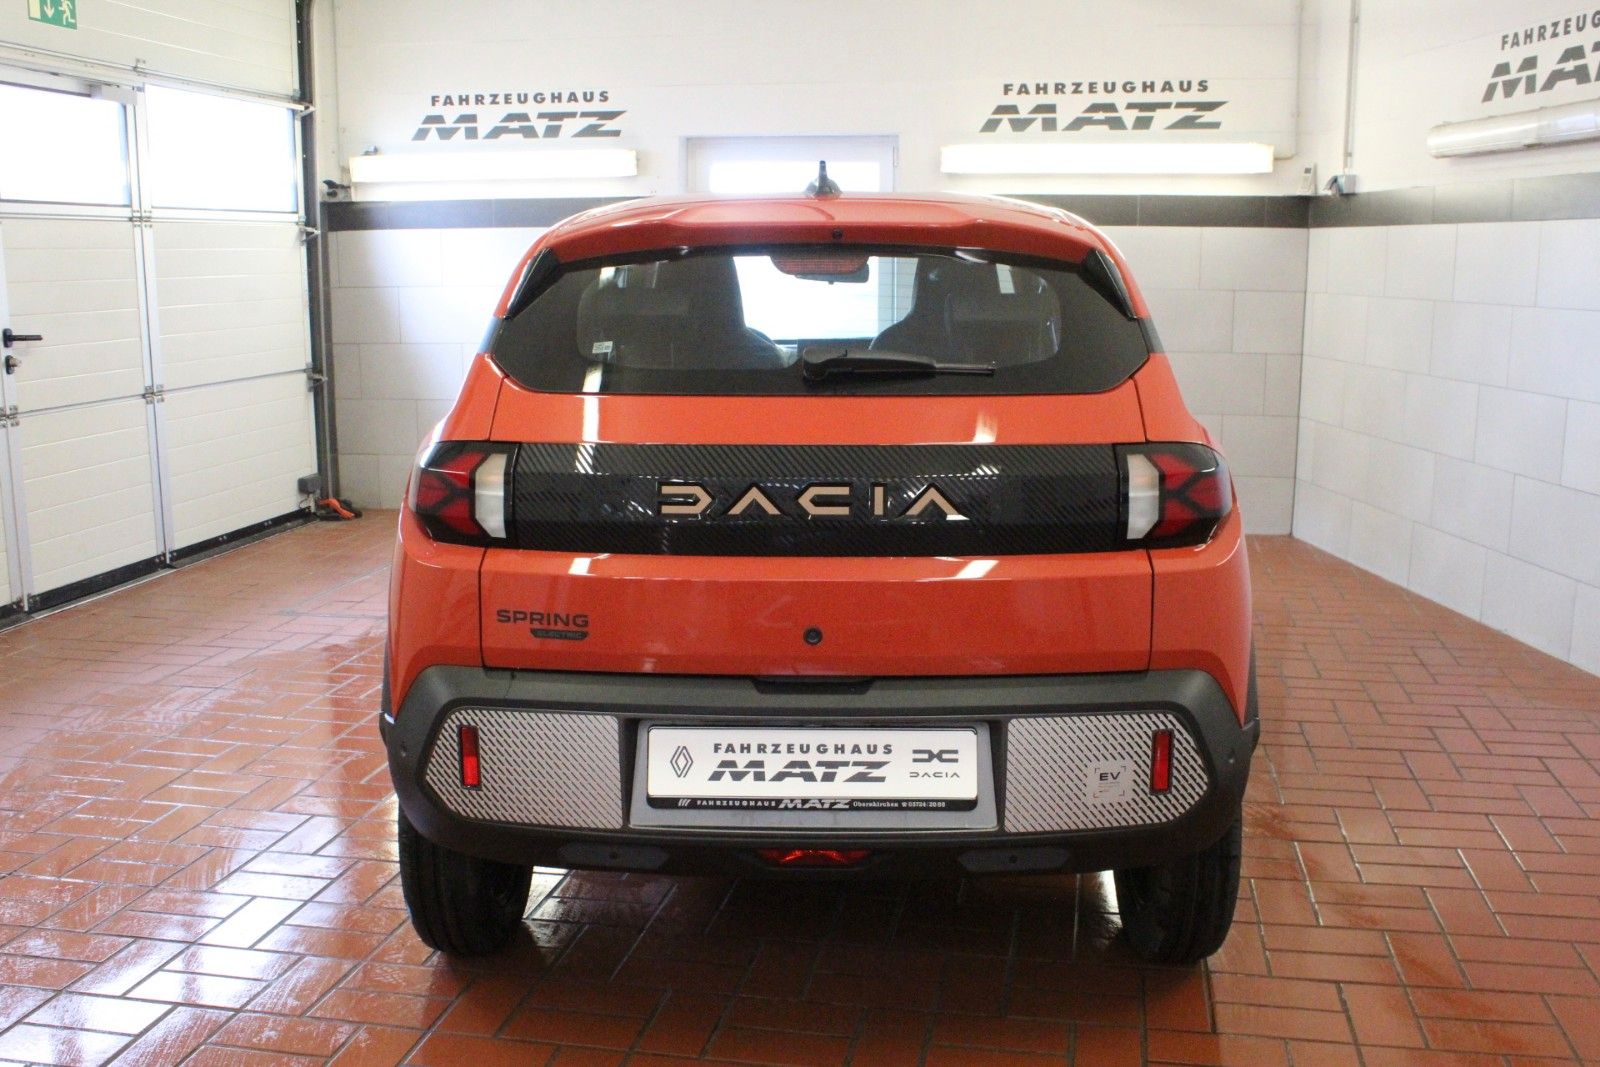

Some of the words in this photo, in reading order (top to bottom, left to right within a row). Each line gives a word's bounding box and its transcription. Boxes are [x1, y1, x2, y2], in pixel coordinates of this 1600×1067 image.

[1481, 40, 1600, 104] MA
[1003, 80, 1209, 95] FAHRZEUGHAUS
[431, 91, 610, 106] FAHRZEUGHAUS
[411, 110, 627, 141] MATZ
[979, 101, 1229, 133] MATZ
[660, 484, 963, 517] DACIA
[496, 609, 589, 628] SPRING
[713, 743, 893, 755] FAHRZEUGHAUS
[708, 760, 891, 783] MATZ
[1099, 771, 1121, 781] EV
[778, 799, 851, 809] MATZ
